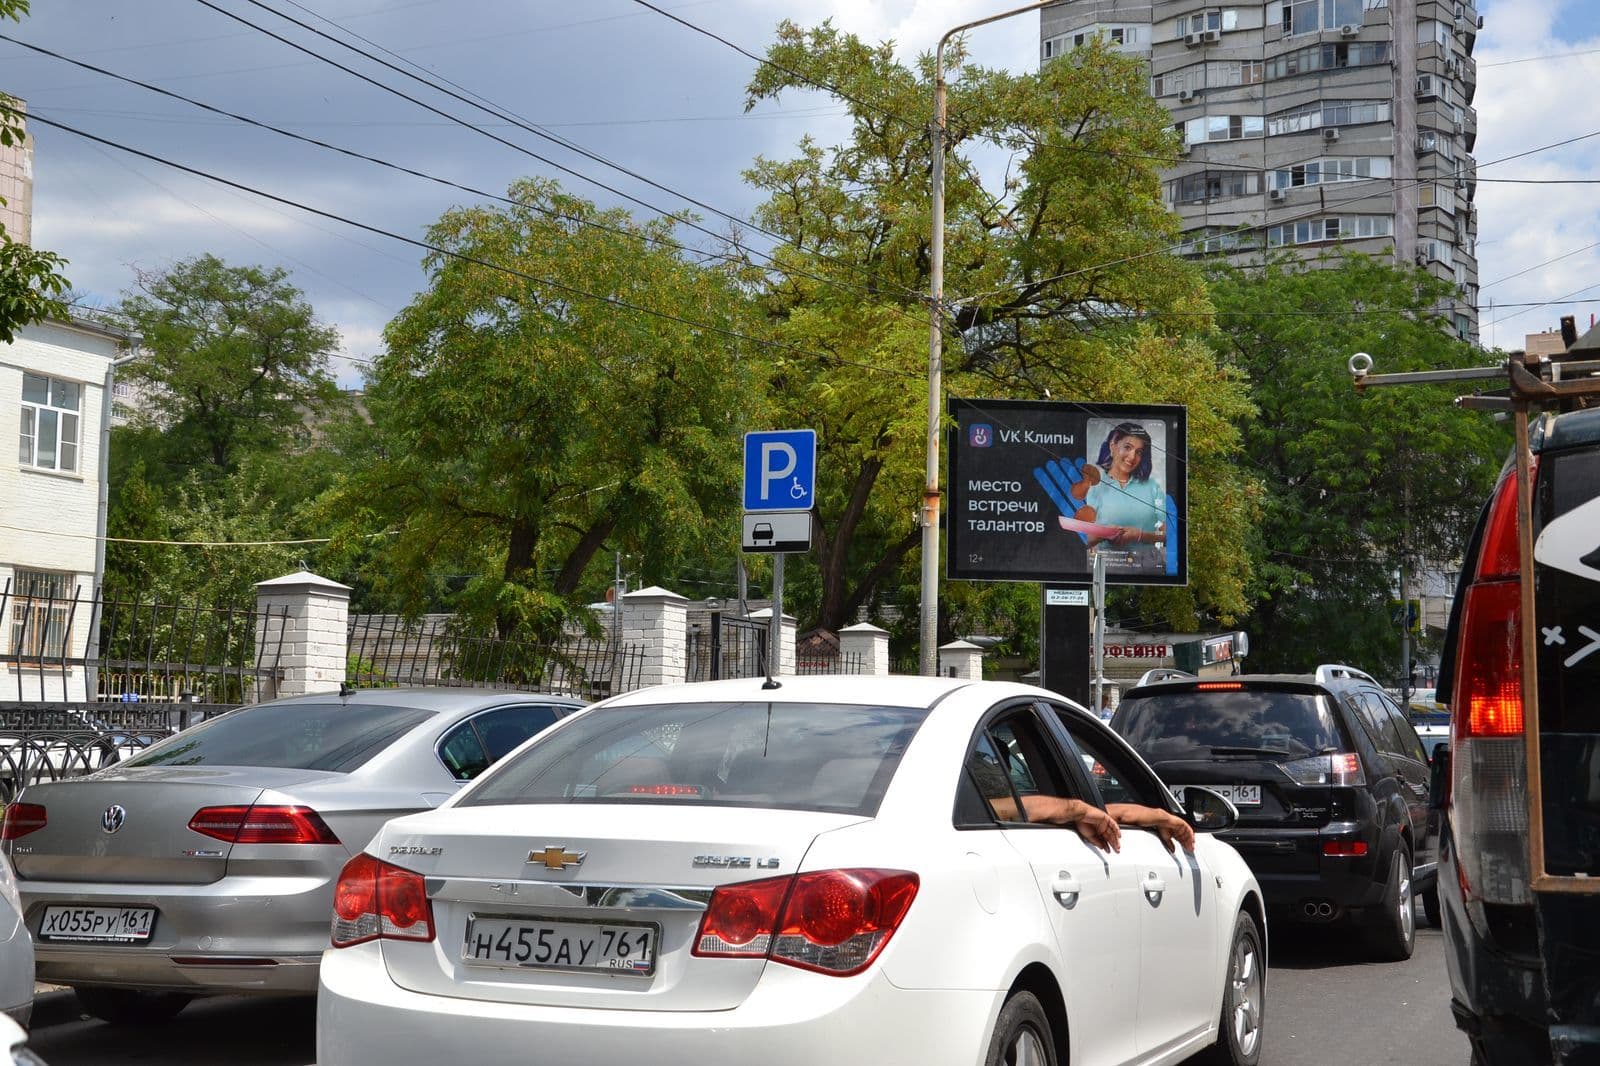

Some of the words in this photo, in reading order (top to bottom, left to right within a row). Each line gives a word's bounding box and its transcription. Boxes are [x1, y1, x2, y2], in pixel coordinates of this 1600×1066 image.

[999, 430, 1021, 444] VK
[1024, 431, 1074, 445] Клипы
[760, 441, 797, 500] P
[968, 480, 1022, 493] место
[968, 500, 1039, 516] встречи
[968, 520, 1046, 534] талантов
[968, 553, 984, 563] 12+
[1089, 644, 1167, 659] ФЕЙНЯ
[1234, 786, 1257, 799] 161
[47, 908, 117, 933] Х055РУ
[121, 910, 150, 929] 161
[475, 927, 594, 966] Н455АУ
[601, 929, 649, 959] 761
[609, 959, 633, 969] RUS
